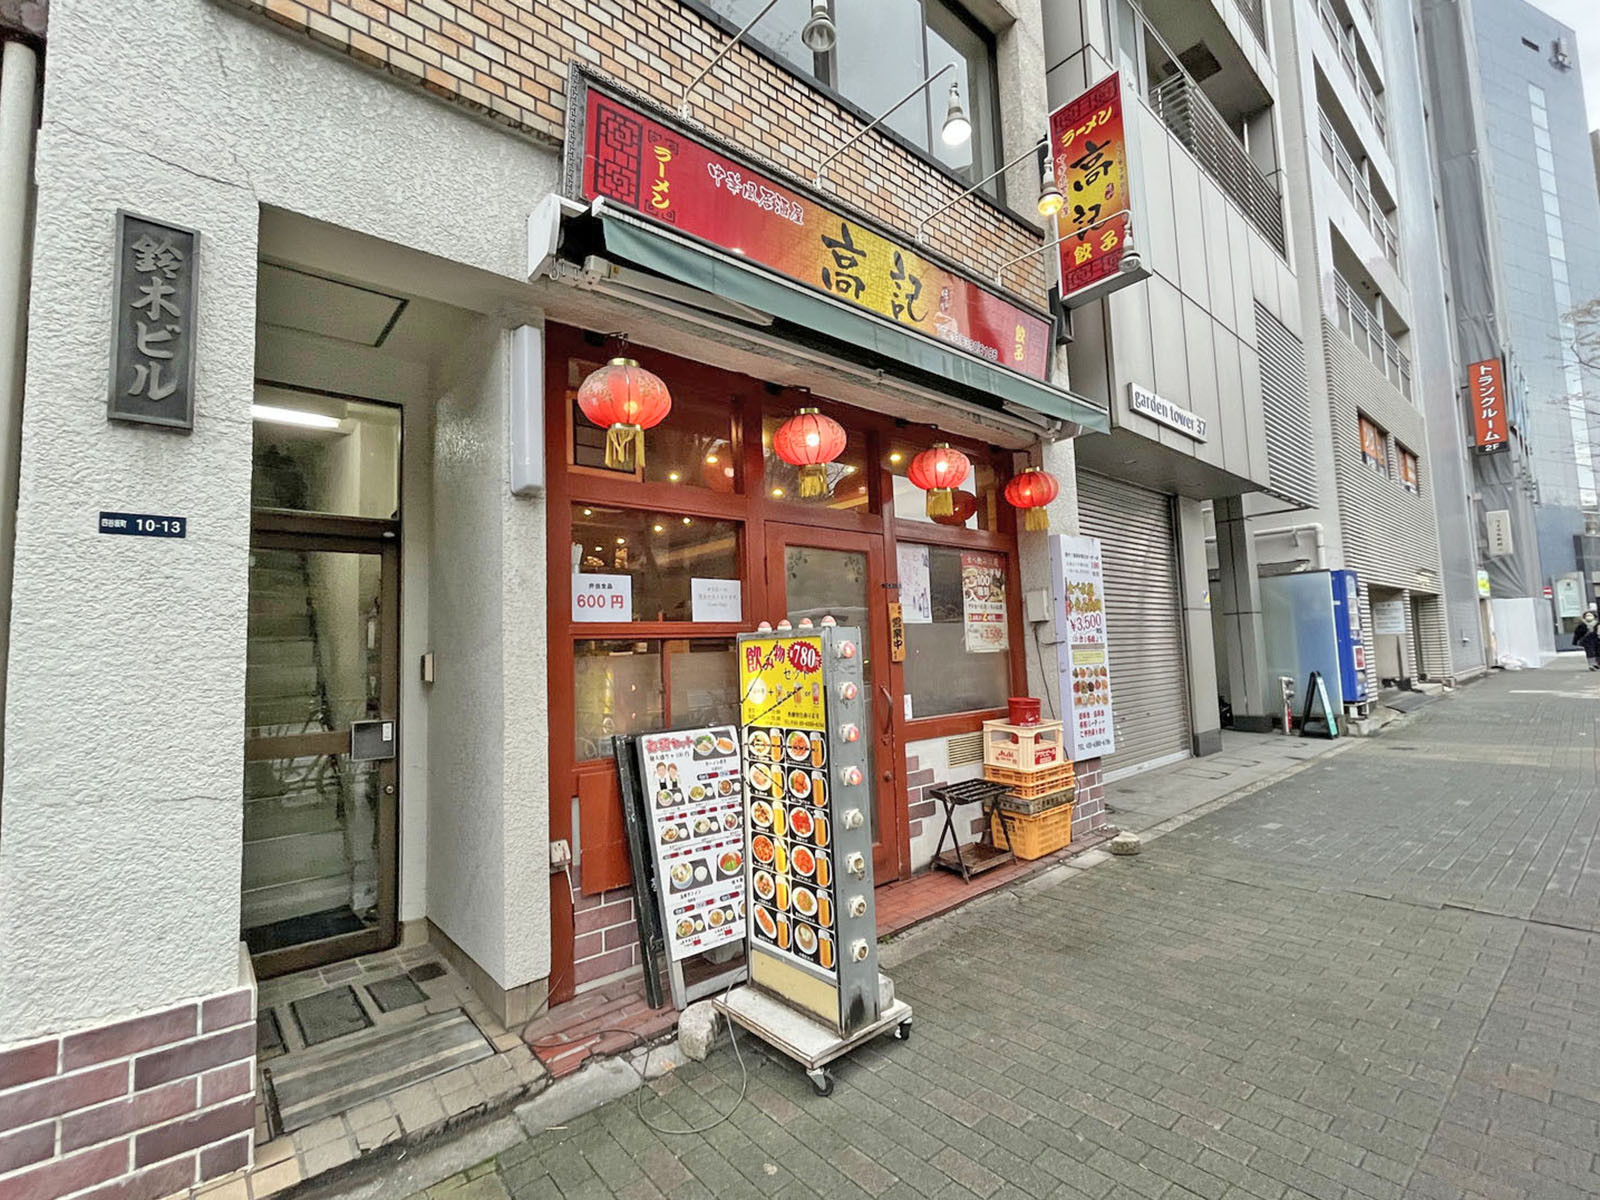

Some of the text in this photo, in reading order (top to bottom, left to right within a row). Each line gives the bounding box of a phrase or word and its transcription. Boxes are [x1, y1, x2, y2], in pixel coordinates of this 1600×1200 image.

[1061, 106, 1112, 147] ラーメン
[651, 145, 673, 209] ラーメン
[821, 222, 929, 322] 高記
[127, 234, 184, 401] 鈴木ビル
[1134, 391, 1207, 436] garden tower 37
[1478, 365, 1501, 442] トランクルーム
[1485, 443, 1500, 452] 2F
[136, 519, 181, 534] 10-13
[577, 594, 624, 608] 600 円
[746, 645, 786, 673] 飲み物
